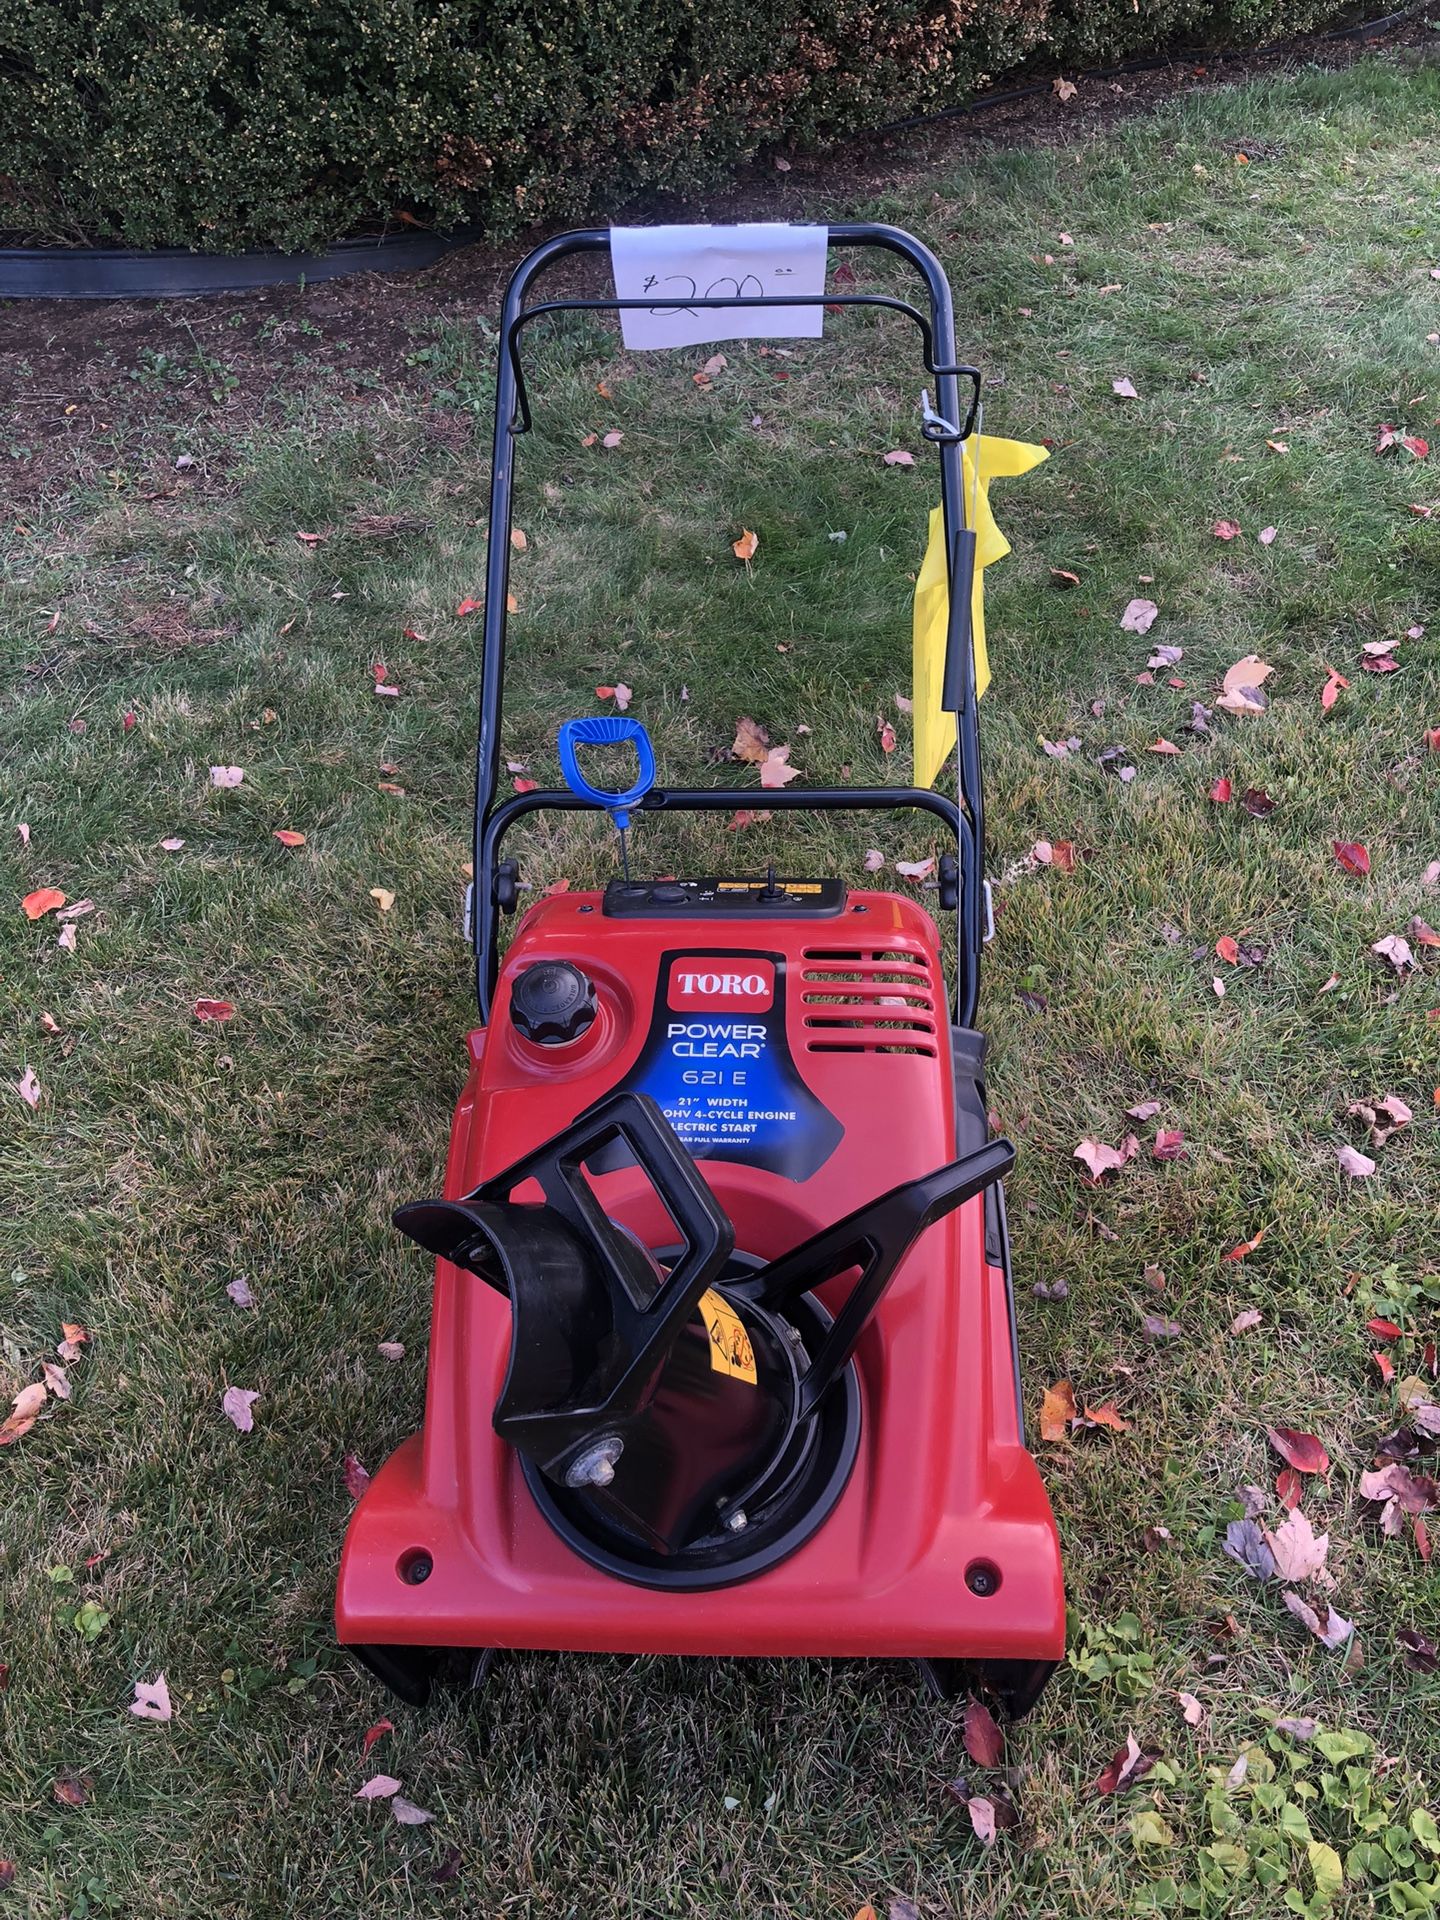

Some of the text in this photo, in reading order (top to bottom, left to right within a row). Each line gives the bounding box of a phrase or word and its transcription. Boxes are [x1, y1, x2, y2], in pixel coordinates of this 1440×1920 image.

[678, 973, 766, 995] TORO
[667, 1023, 767, 1040] POWER
[682, 1070, 747, 1086] 621 E
[707, 1098, 748, 1108] WIDTH
[695, 1110, 744, 1120] 4-CYCLE
[748, 1111, 796, 1121] ENGINE
[672, 1122, 757, 1133] LECTRIC START
